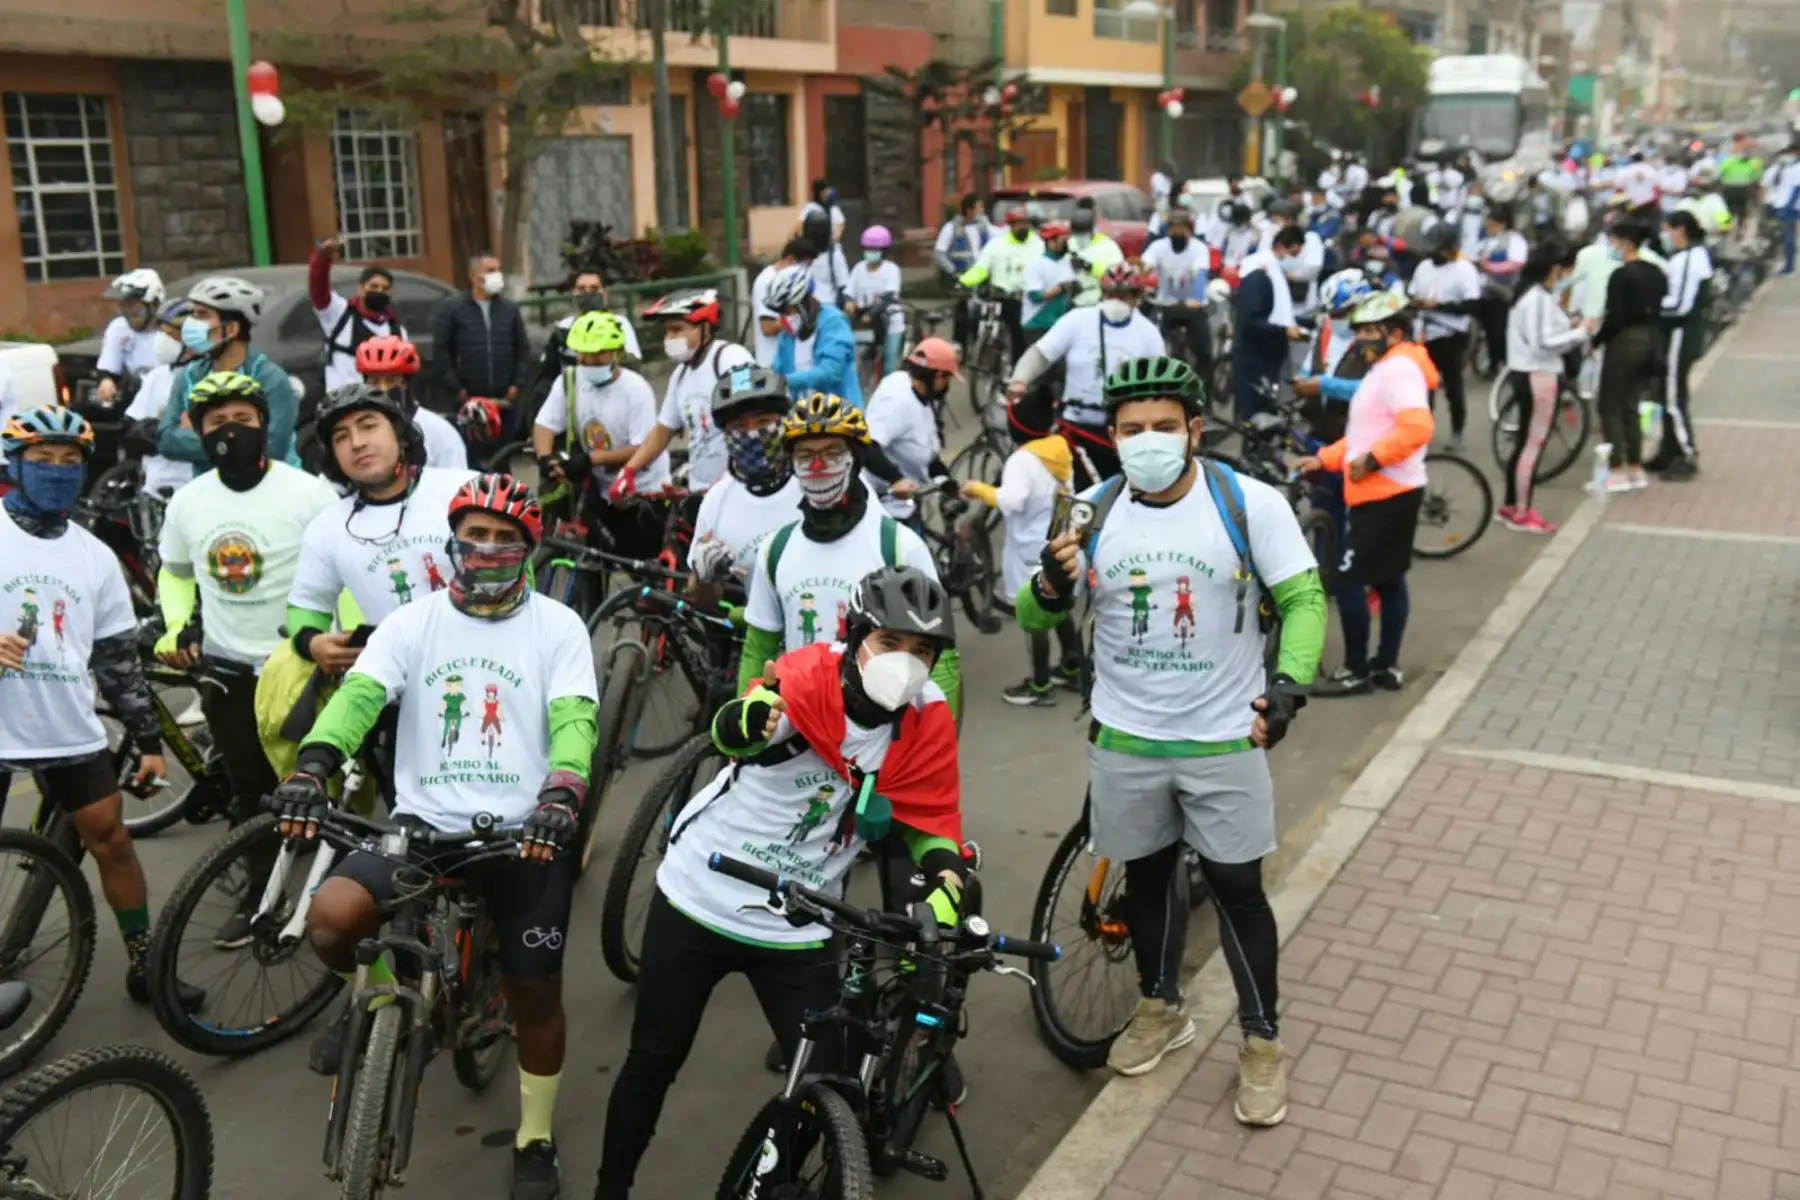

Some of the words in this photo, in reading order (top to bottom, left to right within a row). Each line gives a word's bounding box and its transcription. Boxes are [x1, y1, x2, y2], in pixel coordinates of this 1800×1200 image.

[1105, 552, 1216, 580] BICICLETEADA
[784, 576, 853, 604] BICICLETEA
[1127, 646, 1174, 659] RUMBO
[424, 656, 522, 689] BICICLETEADA
[1113, 655, 1214, 673] BICENTENARIO
[439, 759, 481, 772] RUMBO
[485, 760, 502, 770] AL
[420, 773, 521, 787] BICENTENARIO
[766, 842, 812, 869] RUMBO
